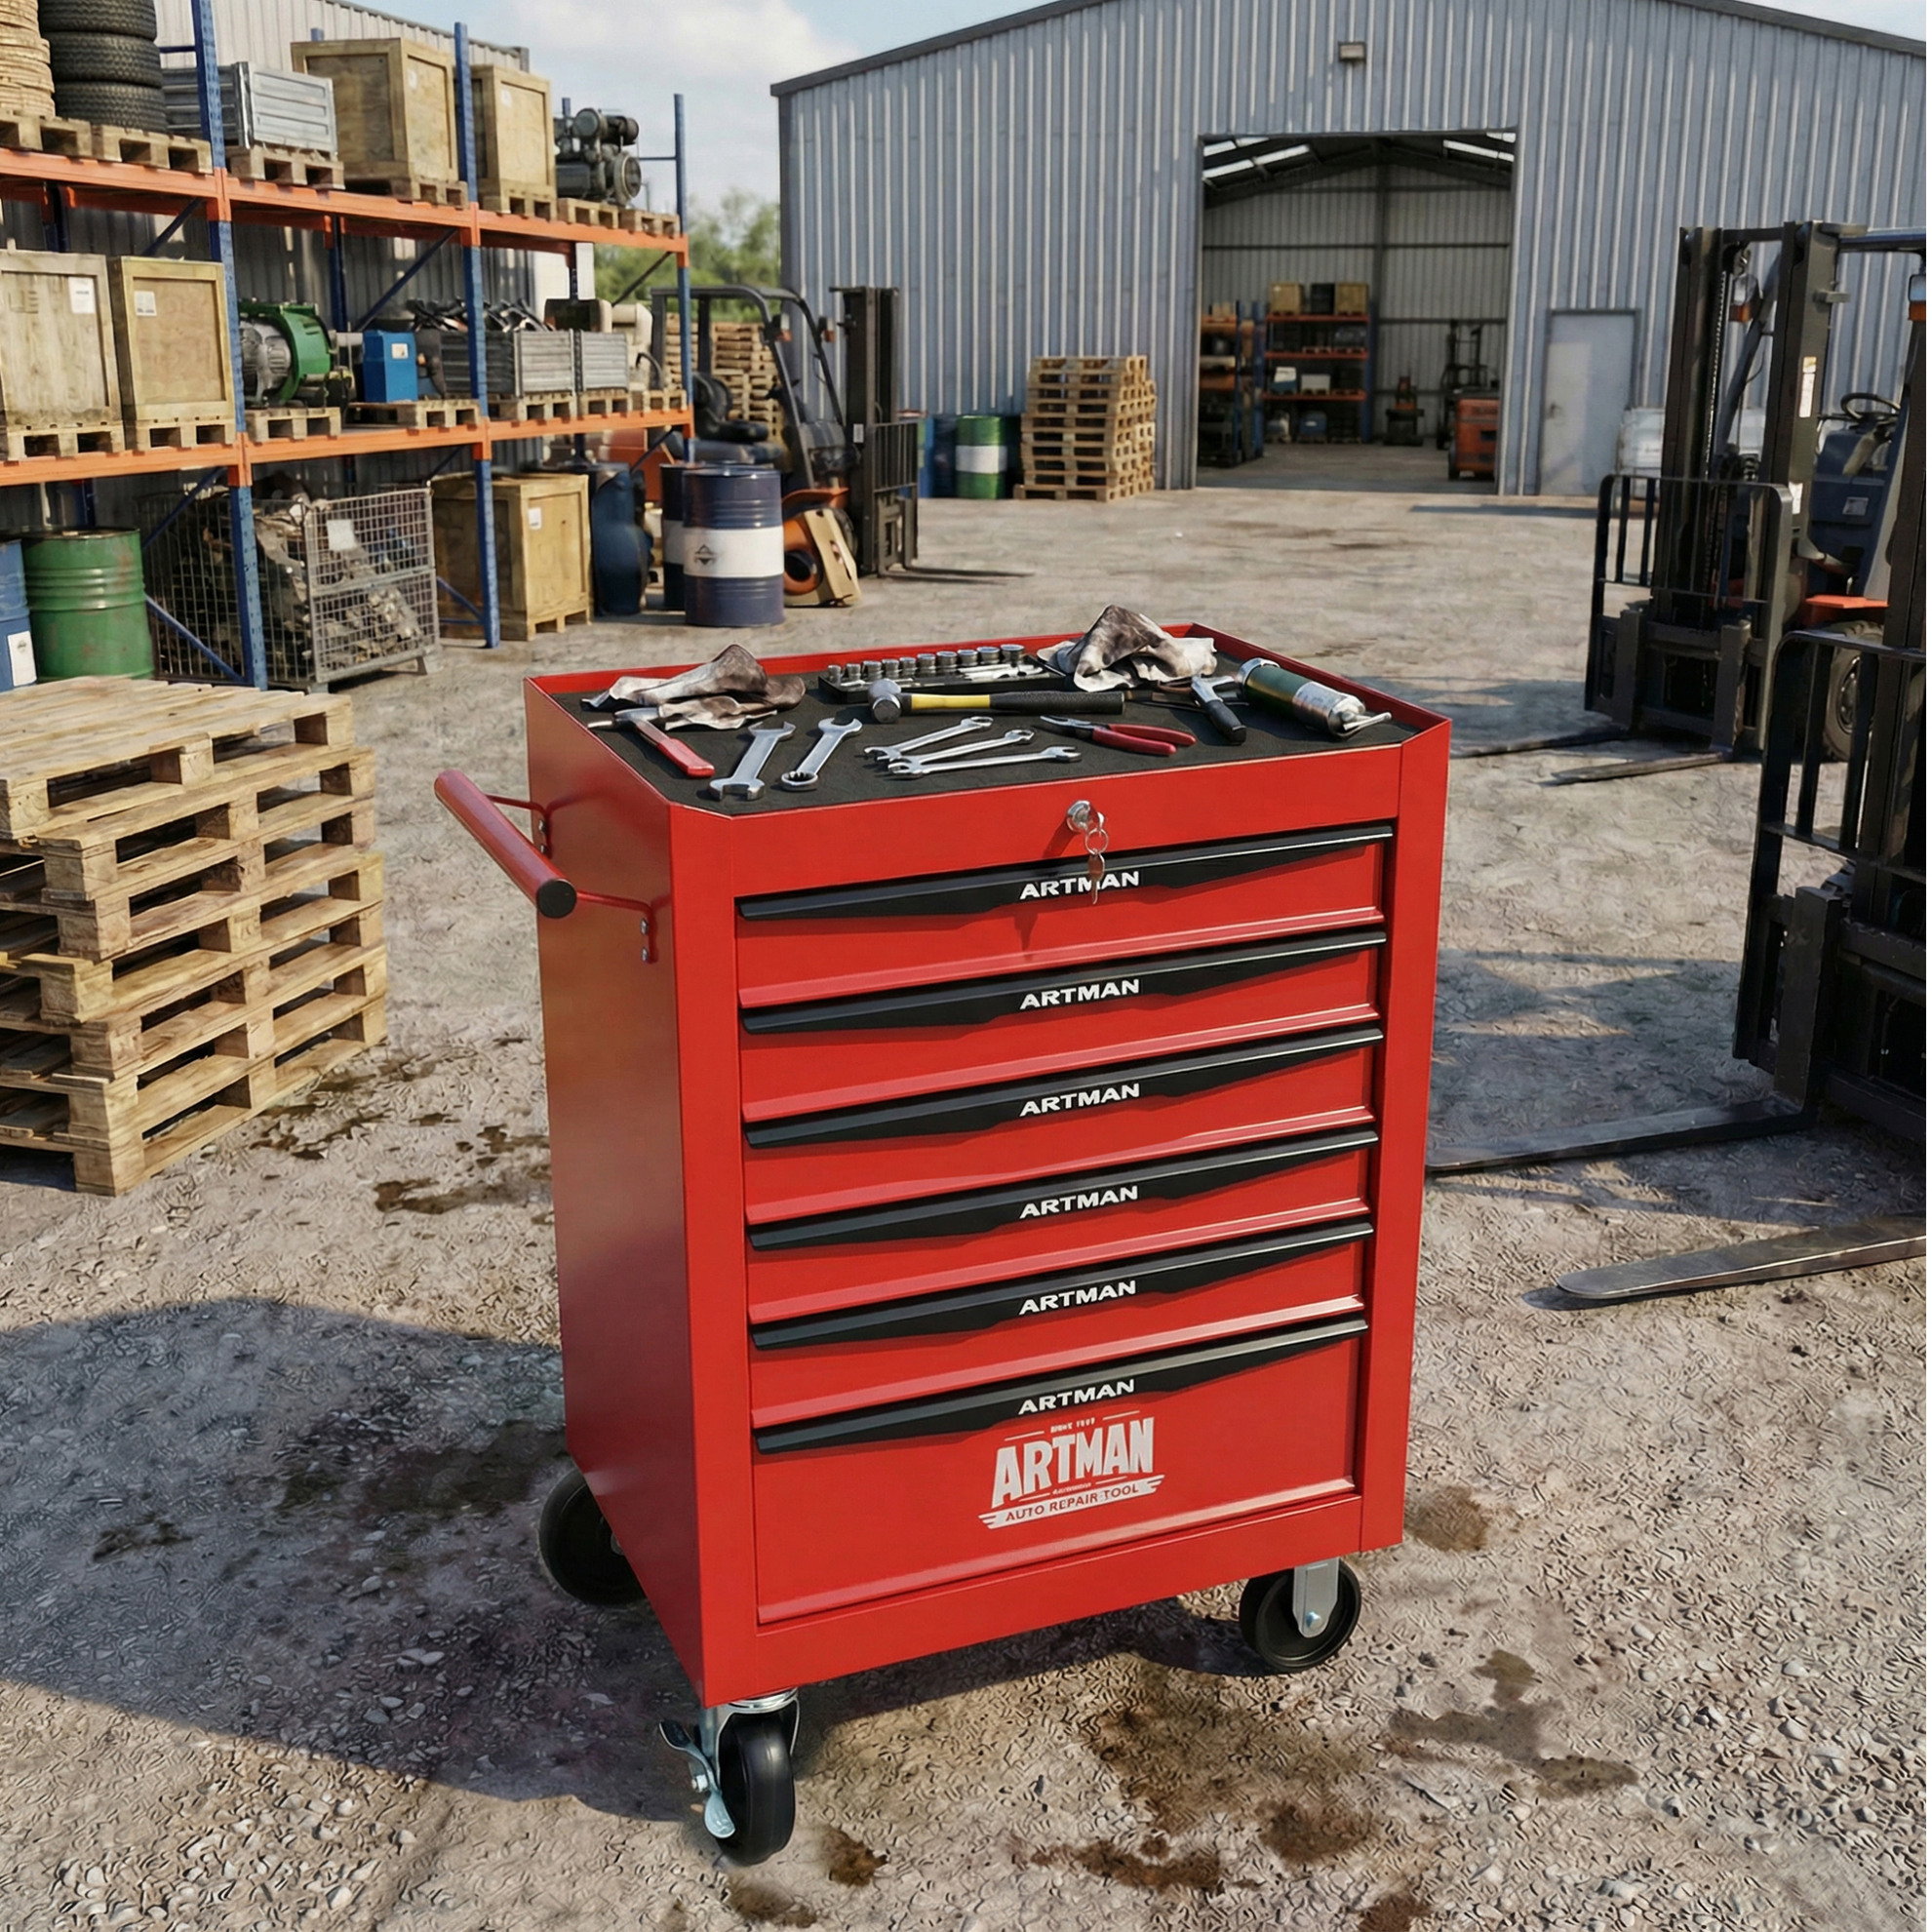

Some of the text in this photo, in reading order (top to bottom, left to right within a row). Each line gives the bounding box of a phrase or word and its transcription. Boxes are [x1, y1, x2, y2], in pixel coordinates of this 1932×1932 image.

[1019, 870, 1139, 900] ARTMAN
[1019, 978, 1140, 1010] ARTMAN
[1019, 1083, 1140, 1117] ARTMAN
[1019, 1185, 1139, 1219] ARTMAN
[1019, 1280, 1137, 1316] ARTMAN
[1018, 1378, 1135, 1415] ARTMAN
[991, 1416, 1155, 1510] ARTMAN
[1005, 1505, 1045, 1522] AUTO
[1049, 1492, 1098, 1513] REPAIR
[1103, 1483, 1139, 1500] TOOL
